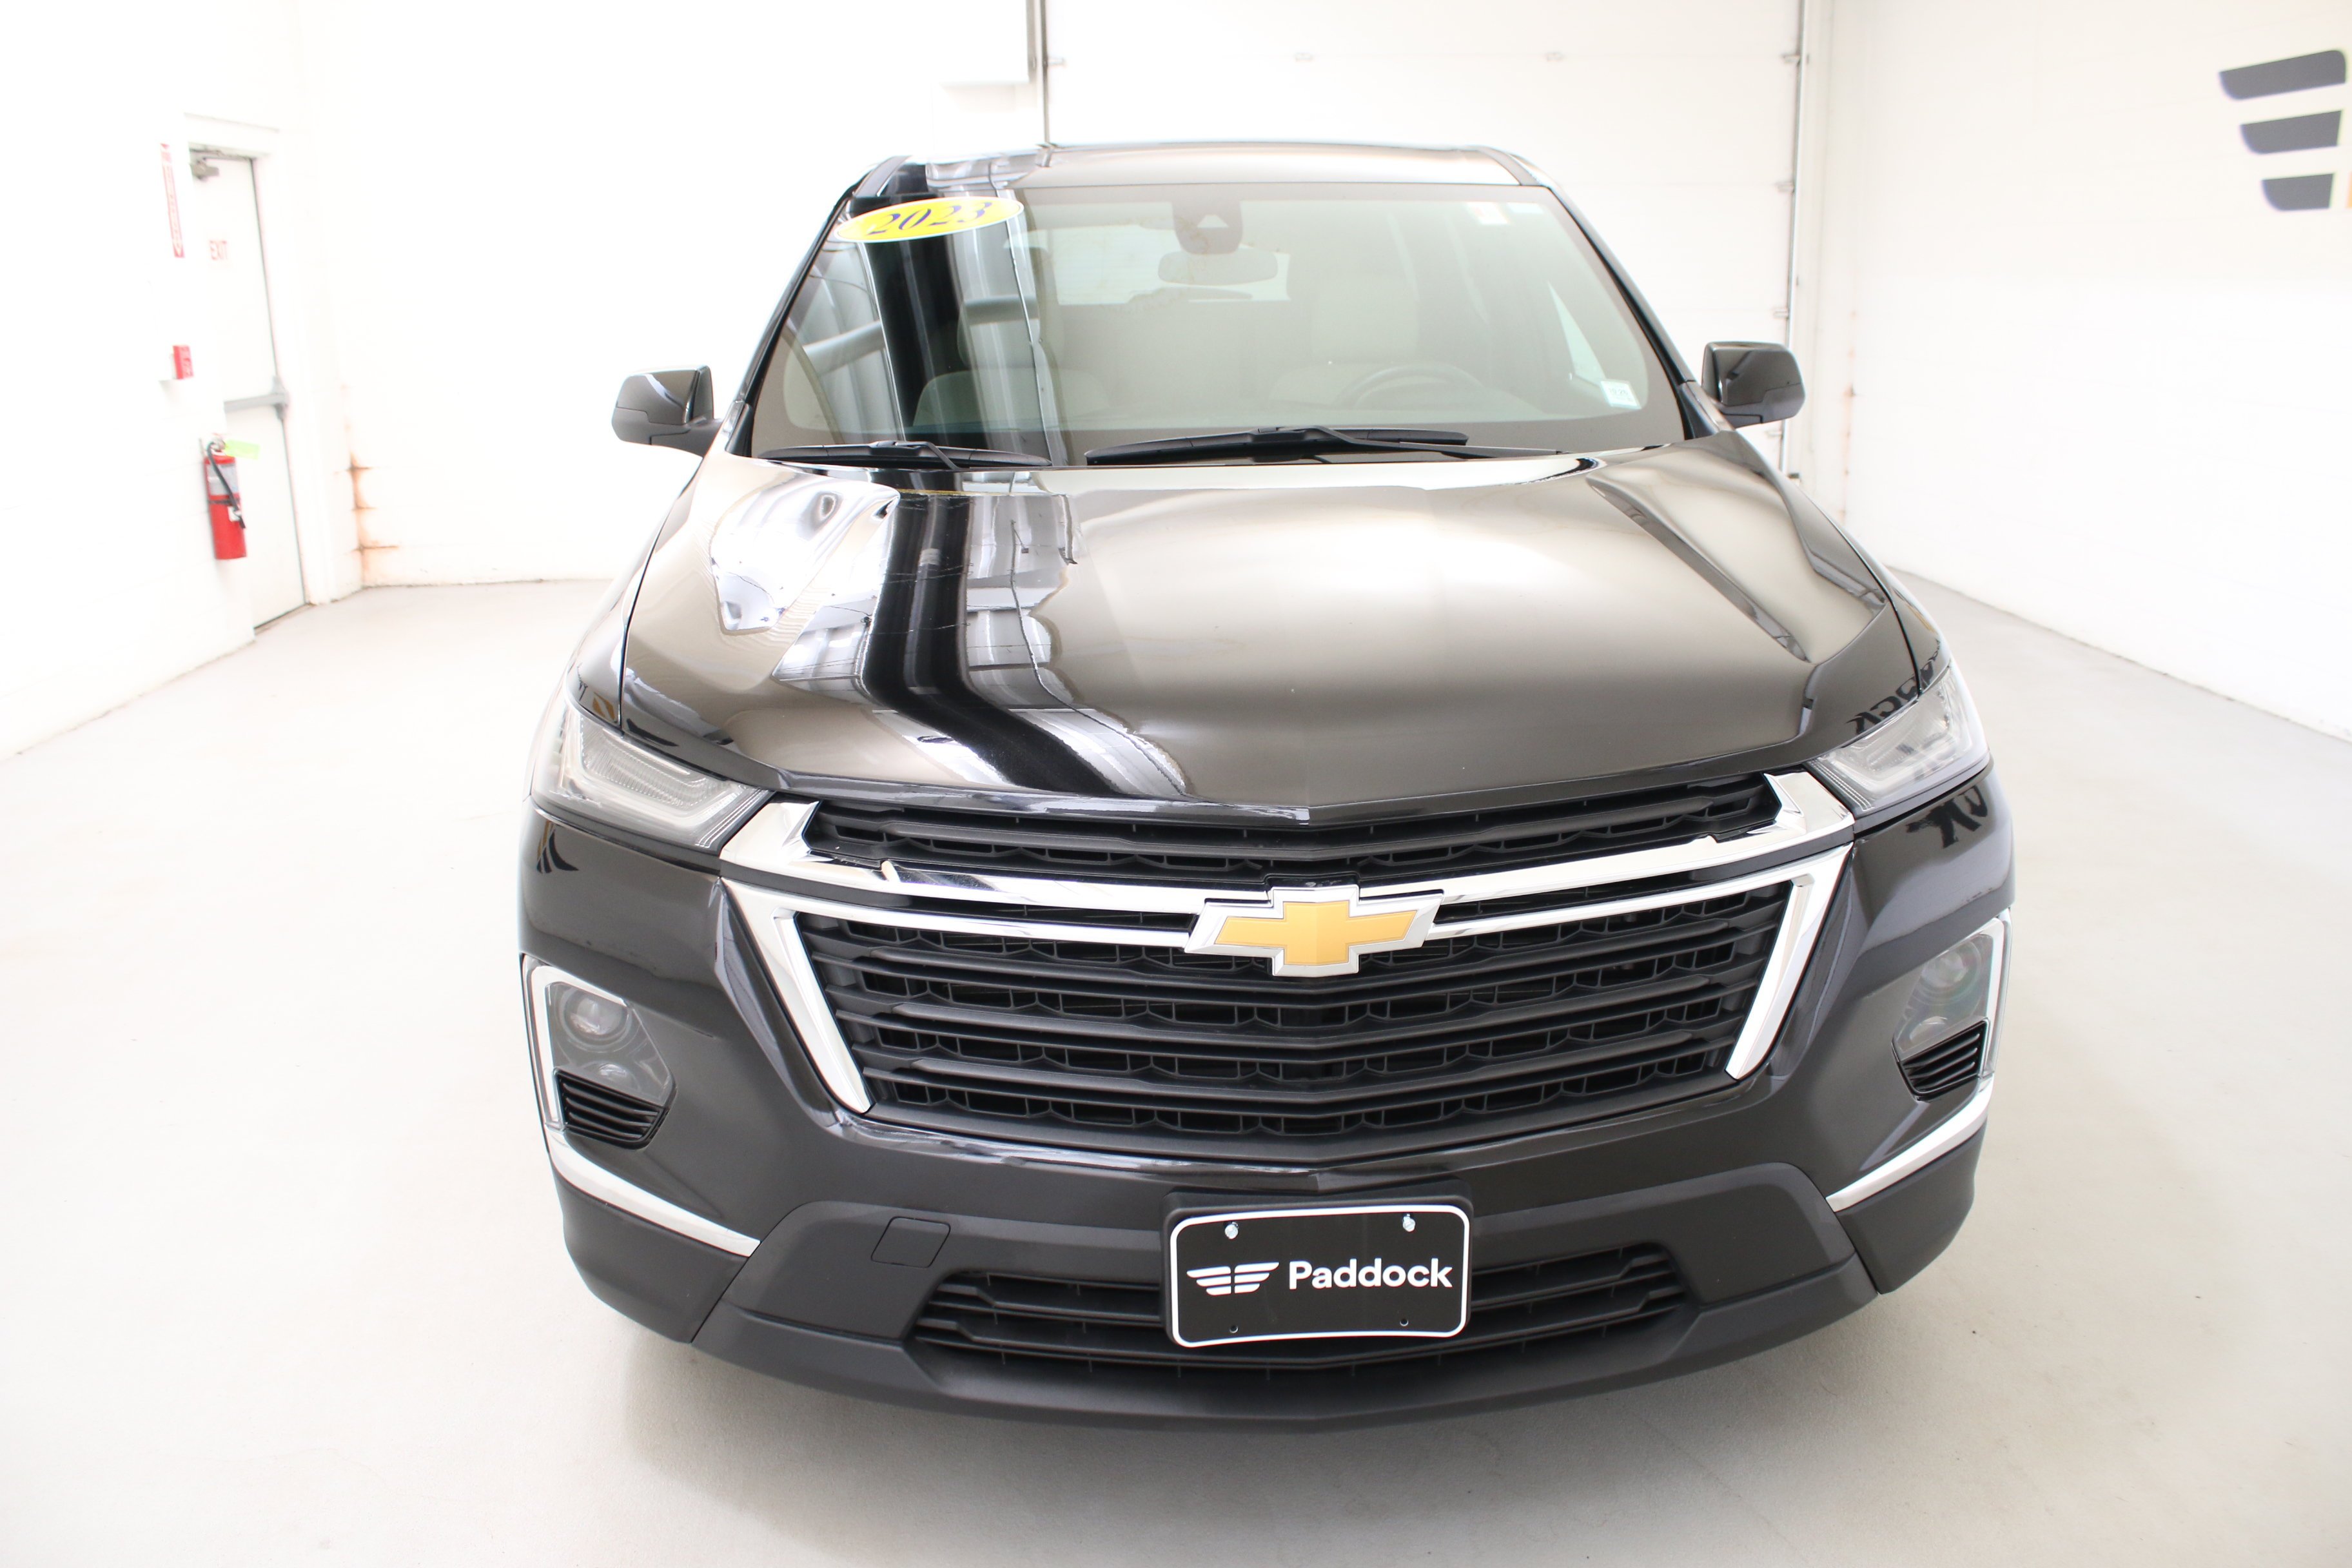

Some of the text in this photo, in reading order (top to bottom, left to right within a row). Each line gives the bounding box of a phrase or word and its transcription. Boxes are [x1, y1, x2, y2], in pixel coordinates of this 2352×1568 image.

[867, 202, 993, 235] 2023
[209, 239, 228, 260] EXIT
[1289, 1257, 1453, 1290] Paddock
